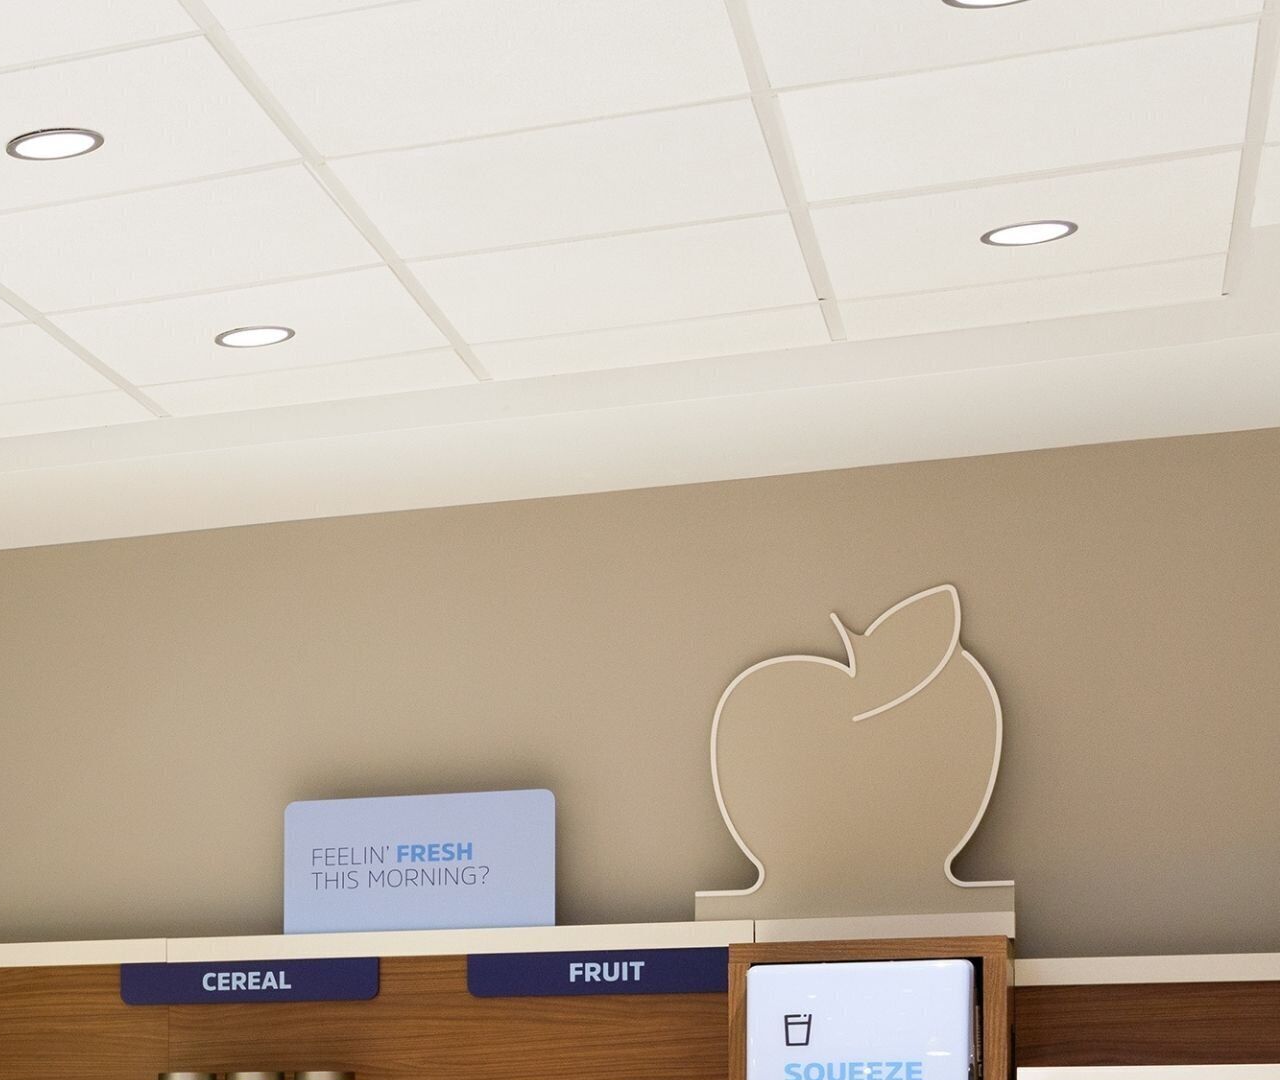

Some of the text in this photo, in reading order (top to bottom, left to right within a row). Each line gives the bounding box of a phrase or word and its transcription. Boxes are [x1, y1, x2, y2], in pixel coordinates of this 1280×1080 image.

[396, 842, 473, 863] FRESH
[311, 865, 490, 890] THIS MORNING?
[202, 971, 292, 991] CEREAL
[569, 961, 645, 982] FRUIT
